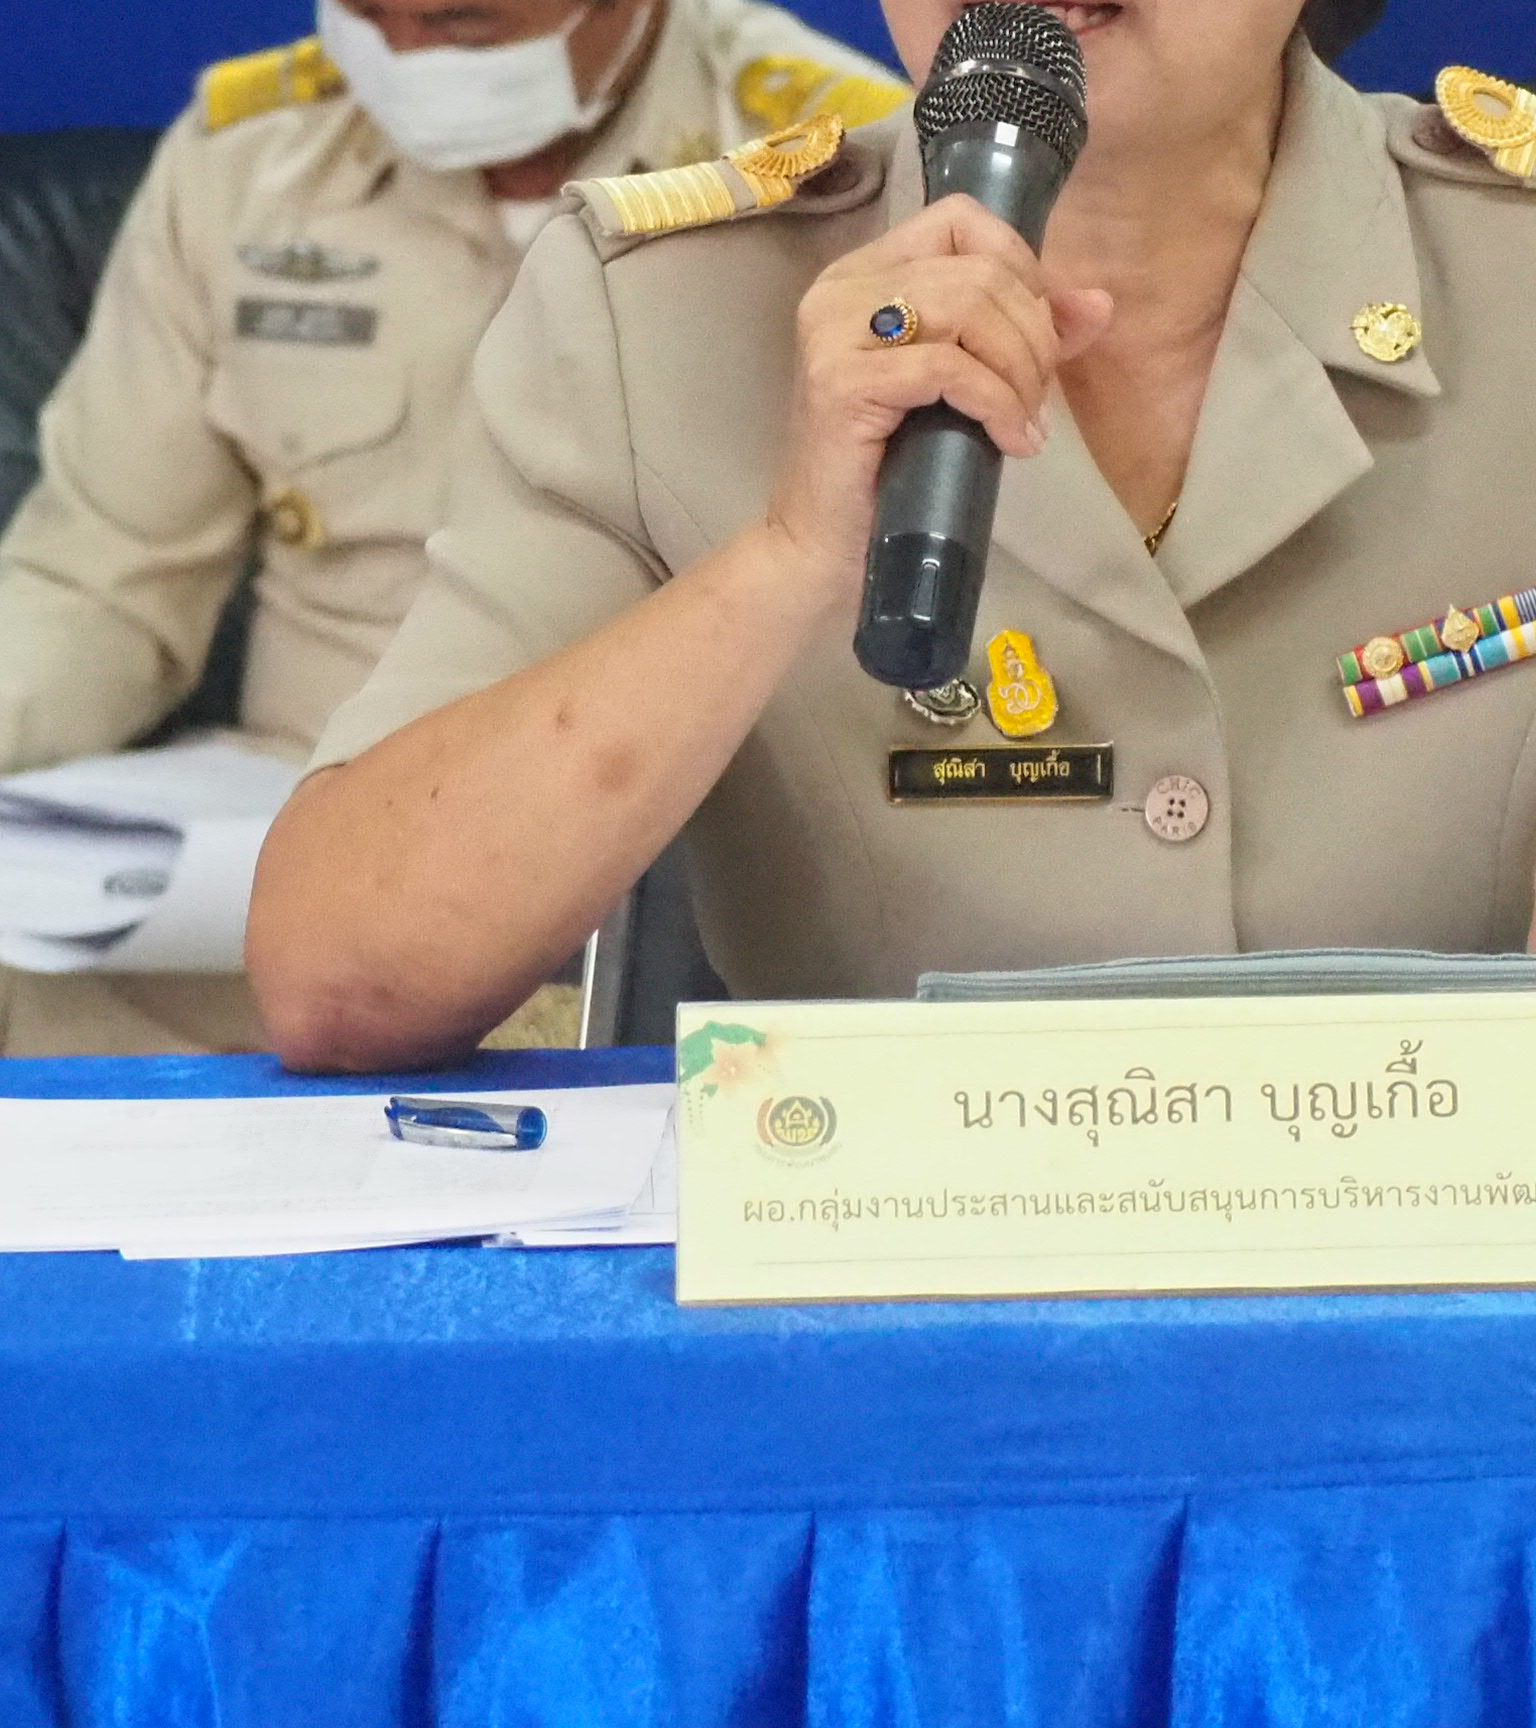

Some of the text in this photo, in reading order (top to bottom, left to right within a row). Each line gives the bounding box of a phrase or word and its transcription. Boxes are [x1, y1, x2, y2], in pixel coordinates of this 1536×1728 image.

[933, 749, 1071, 786] สุณิสา บุญเกื้อ
[953, 1039, 1459, 1148] นางสุณิสา บุญเกื้อ
